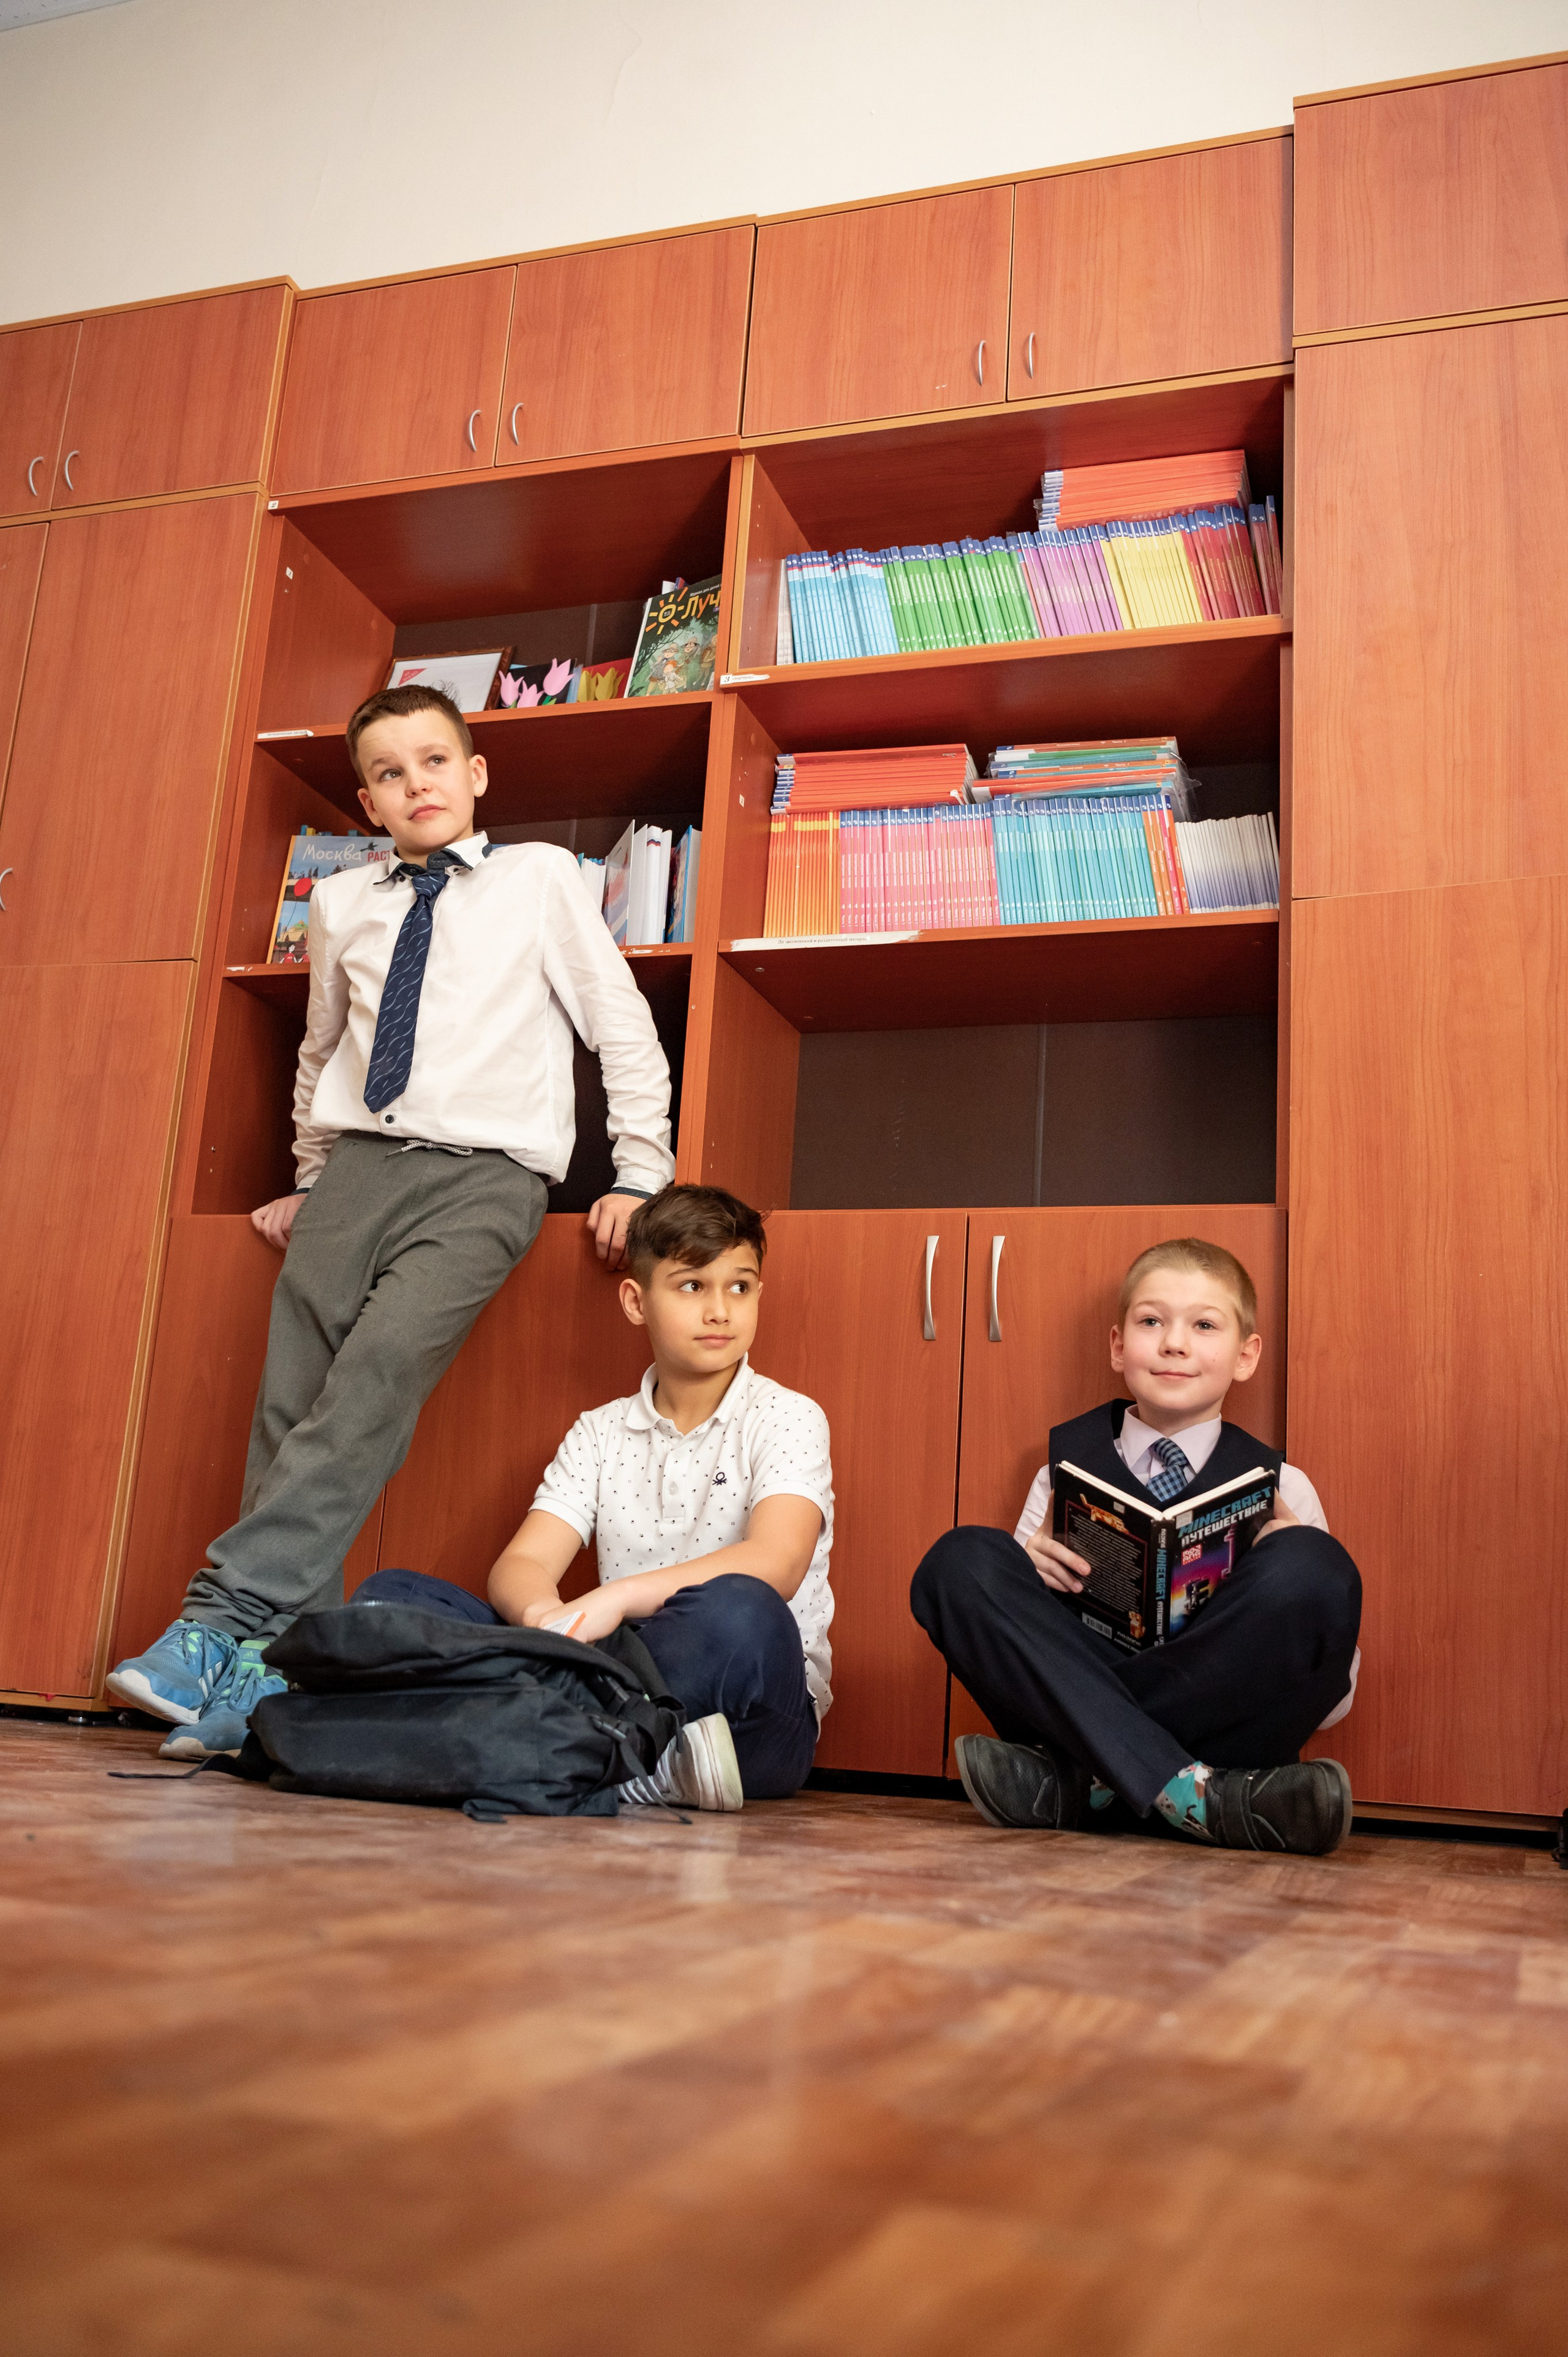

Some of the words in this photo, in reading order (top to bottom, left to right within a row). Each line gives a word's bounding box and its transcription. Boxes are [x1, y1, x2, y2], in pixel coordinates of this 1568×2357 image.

[302, 843, 362, 861] Москва
[1178, 1486, 1271, 1538] MINECRAFT
[1182, 1499, 1267, 1547] ПУТЕШЕСТВИЕ
[1156, 1548, 1167, 1601] MINECRAFT
